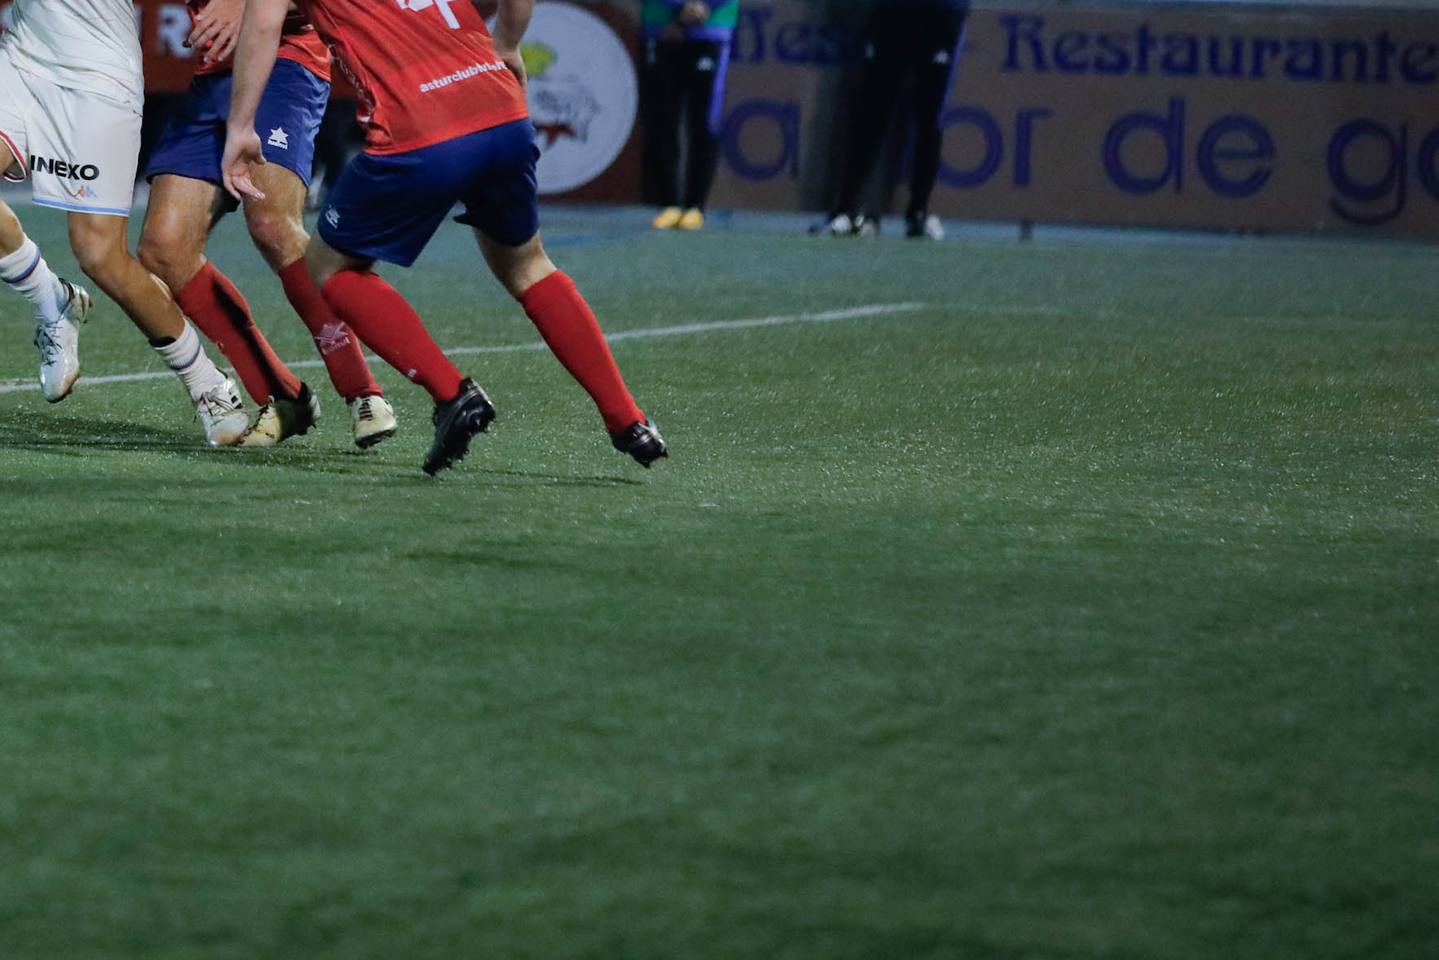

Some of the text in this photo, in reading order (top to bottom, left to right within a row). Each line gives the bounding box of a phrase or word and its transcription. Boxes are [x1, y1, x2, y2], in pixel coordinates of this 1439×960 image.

[999, 13, 1439, 85] Restaurante
[30, 154, 100, 181] INEXO
[1102, 95, 1276, 199] de
